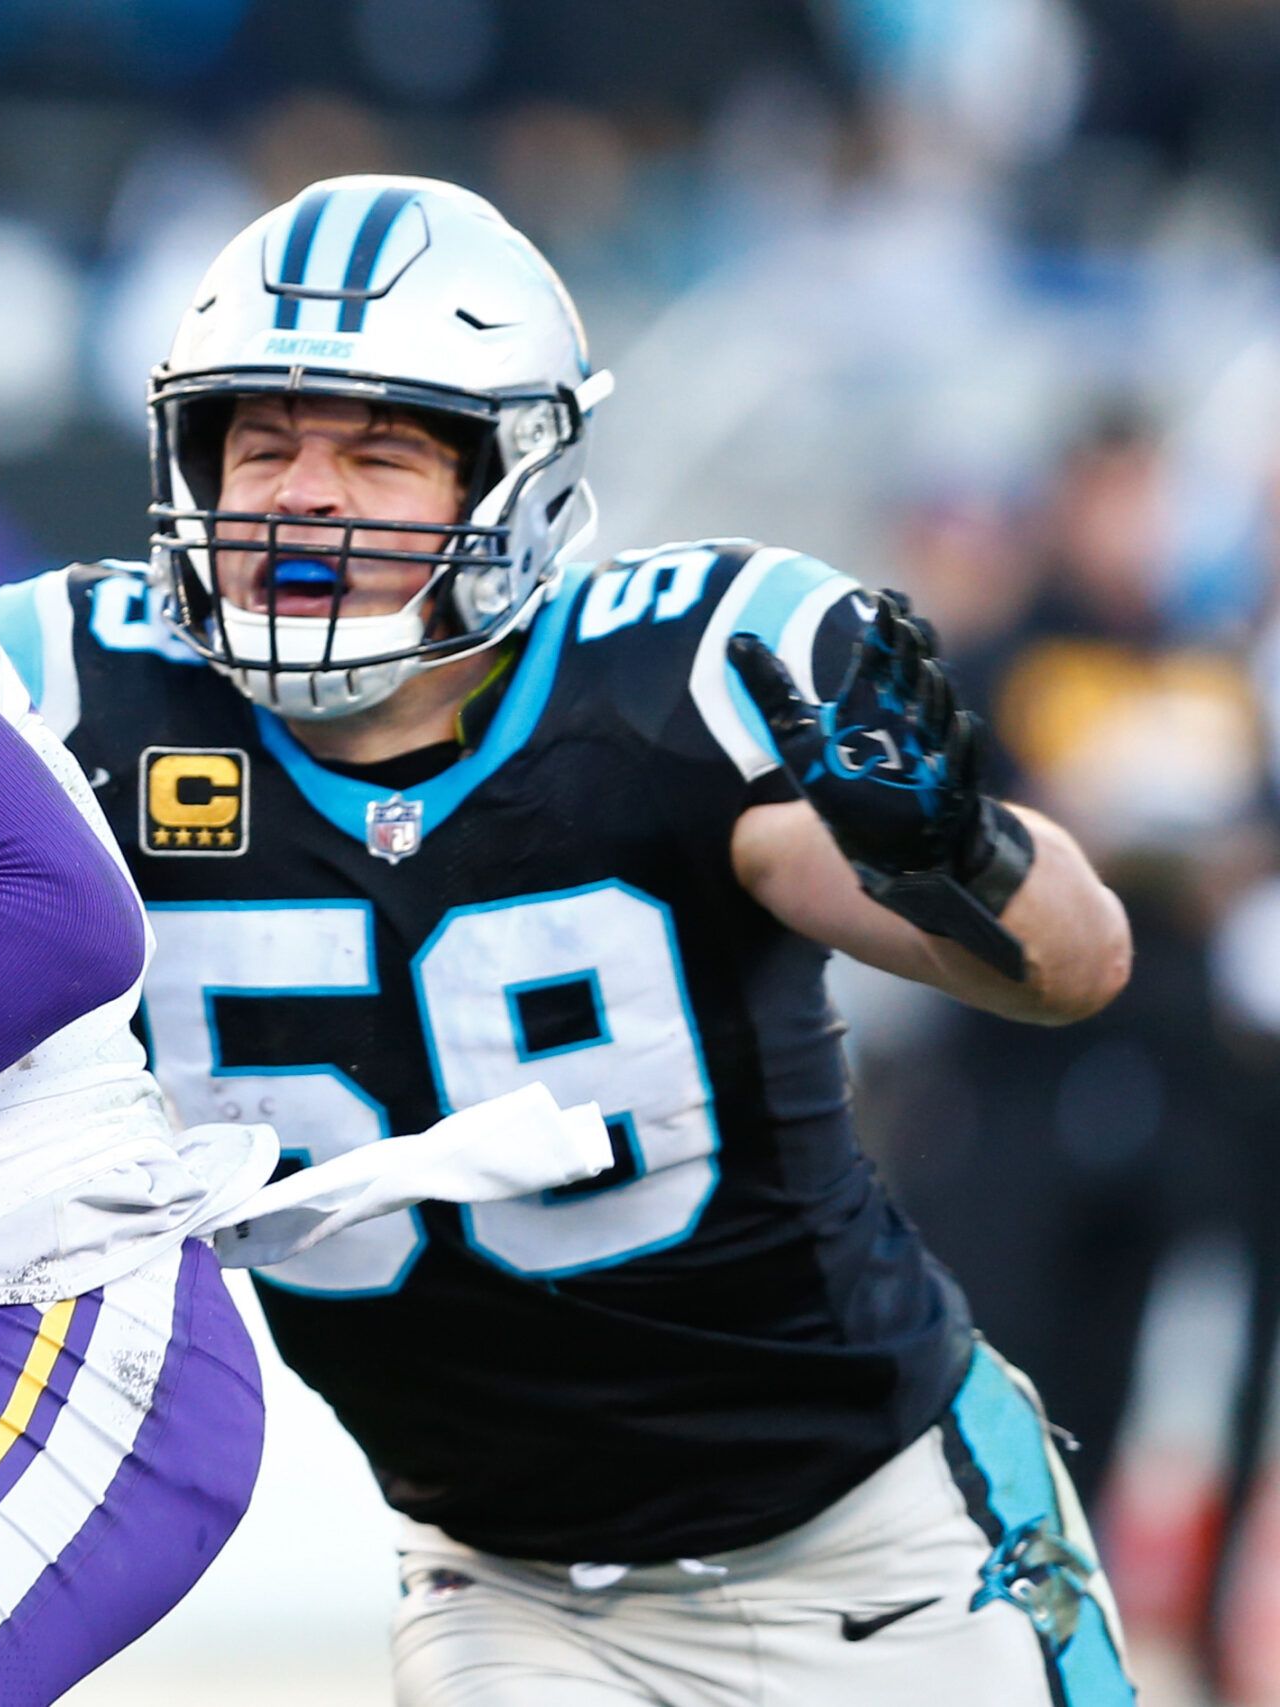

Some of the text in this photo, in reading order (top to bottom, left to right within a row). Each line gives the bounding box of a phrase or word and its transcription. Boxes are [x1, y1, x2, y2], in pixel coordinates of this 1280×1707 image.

[263, 337, 356, 359] PANTHERS
[148, 754, 240, 828] C
[143, 878, 721, 1300] 59
